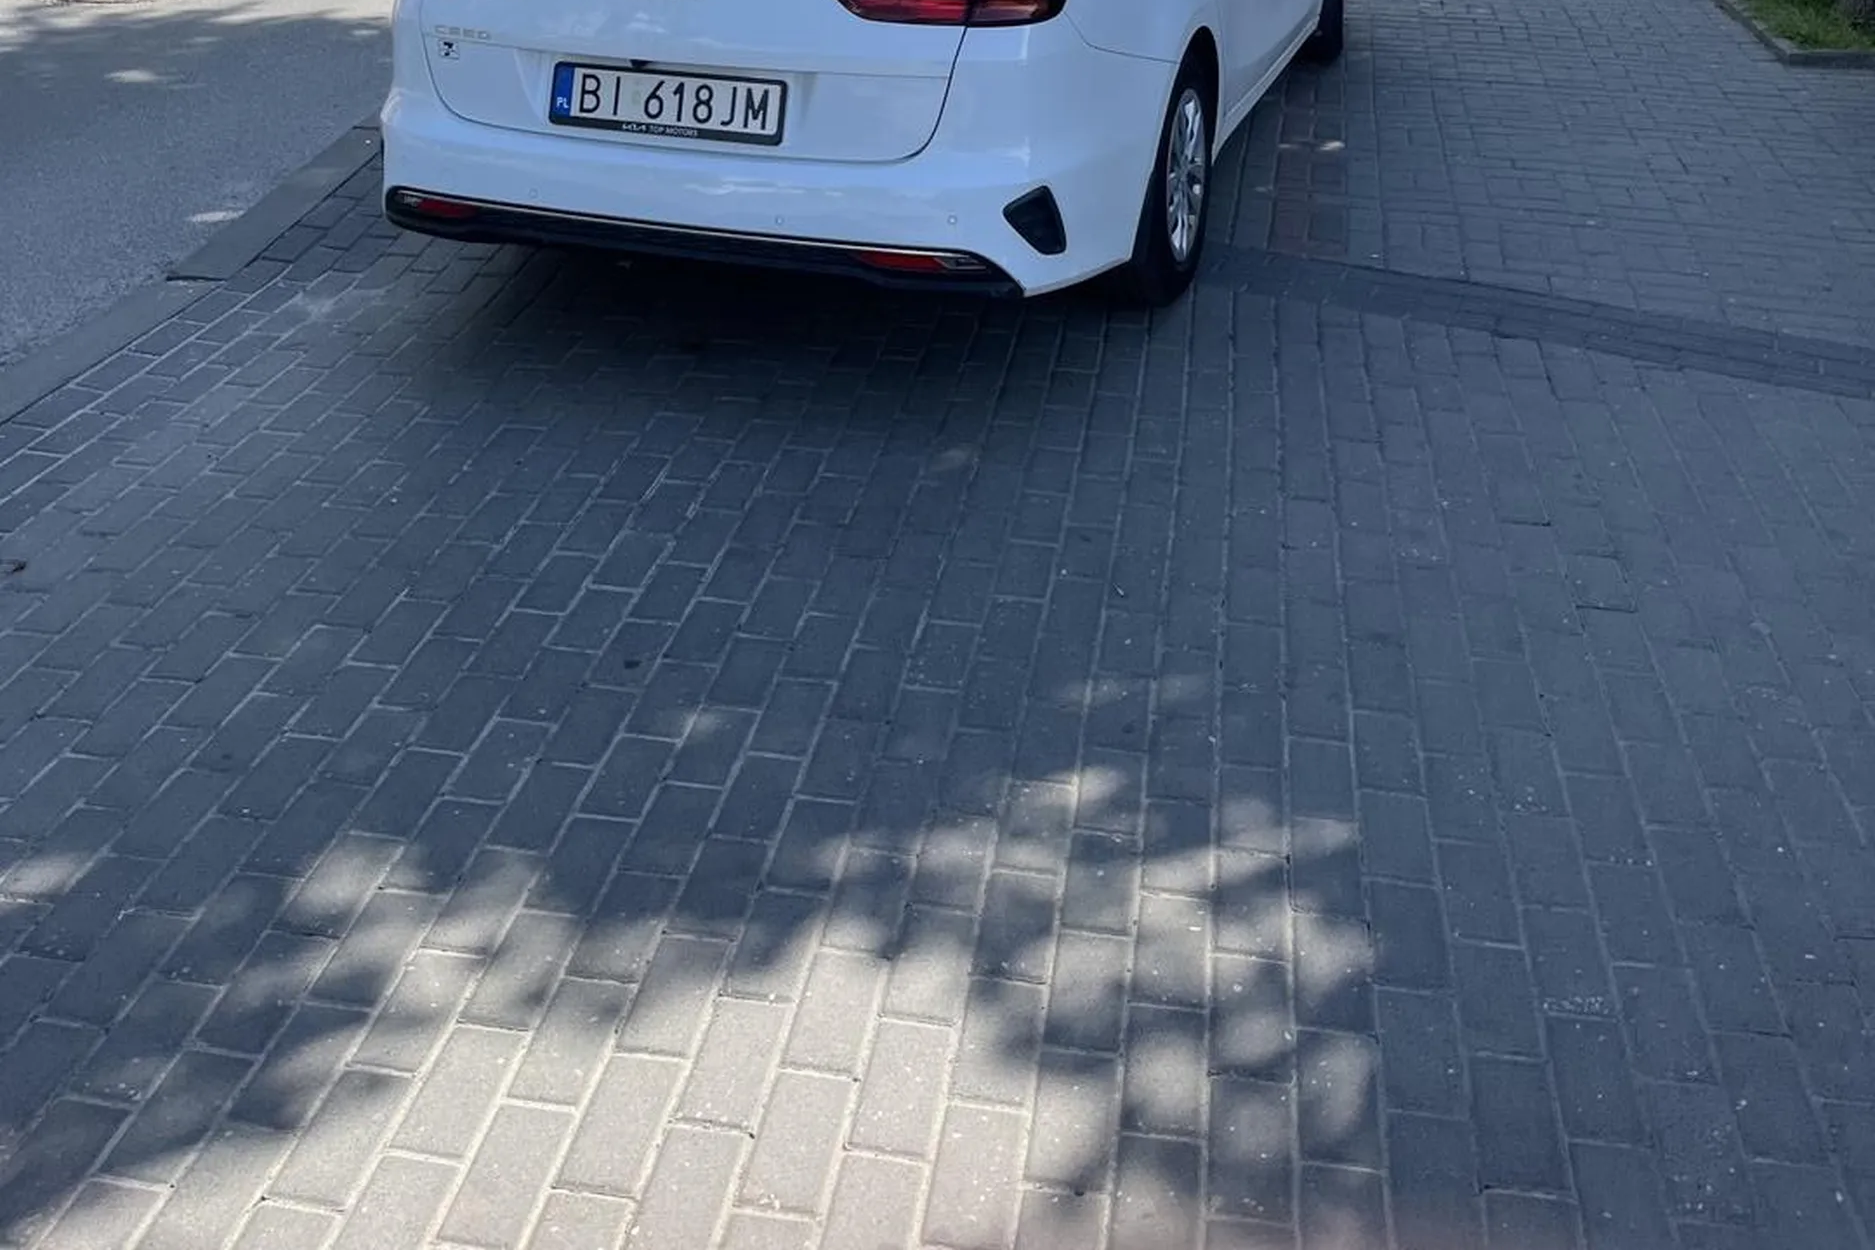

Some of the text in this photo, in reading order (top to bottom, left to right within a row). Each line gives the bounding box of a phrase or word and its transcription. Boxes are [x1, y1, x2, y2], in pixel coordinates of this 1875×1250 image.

[556, 96, 570, 109] PL
[578, 73, 770, 131] BI 618JM
